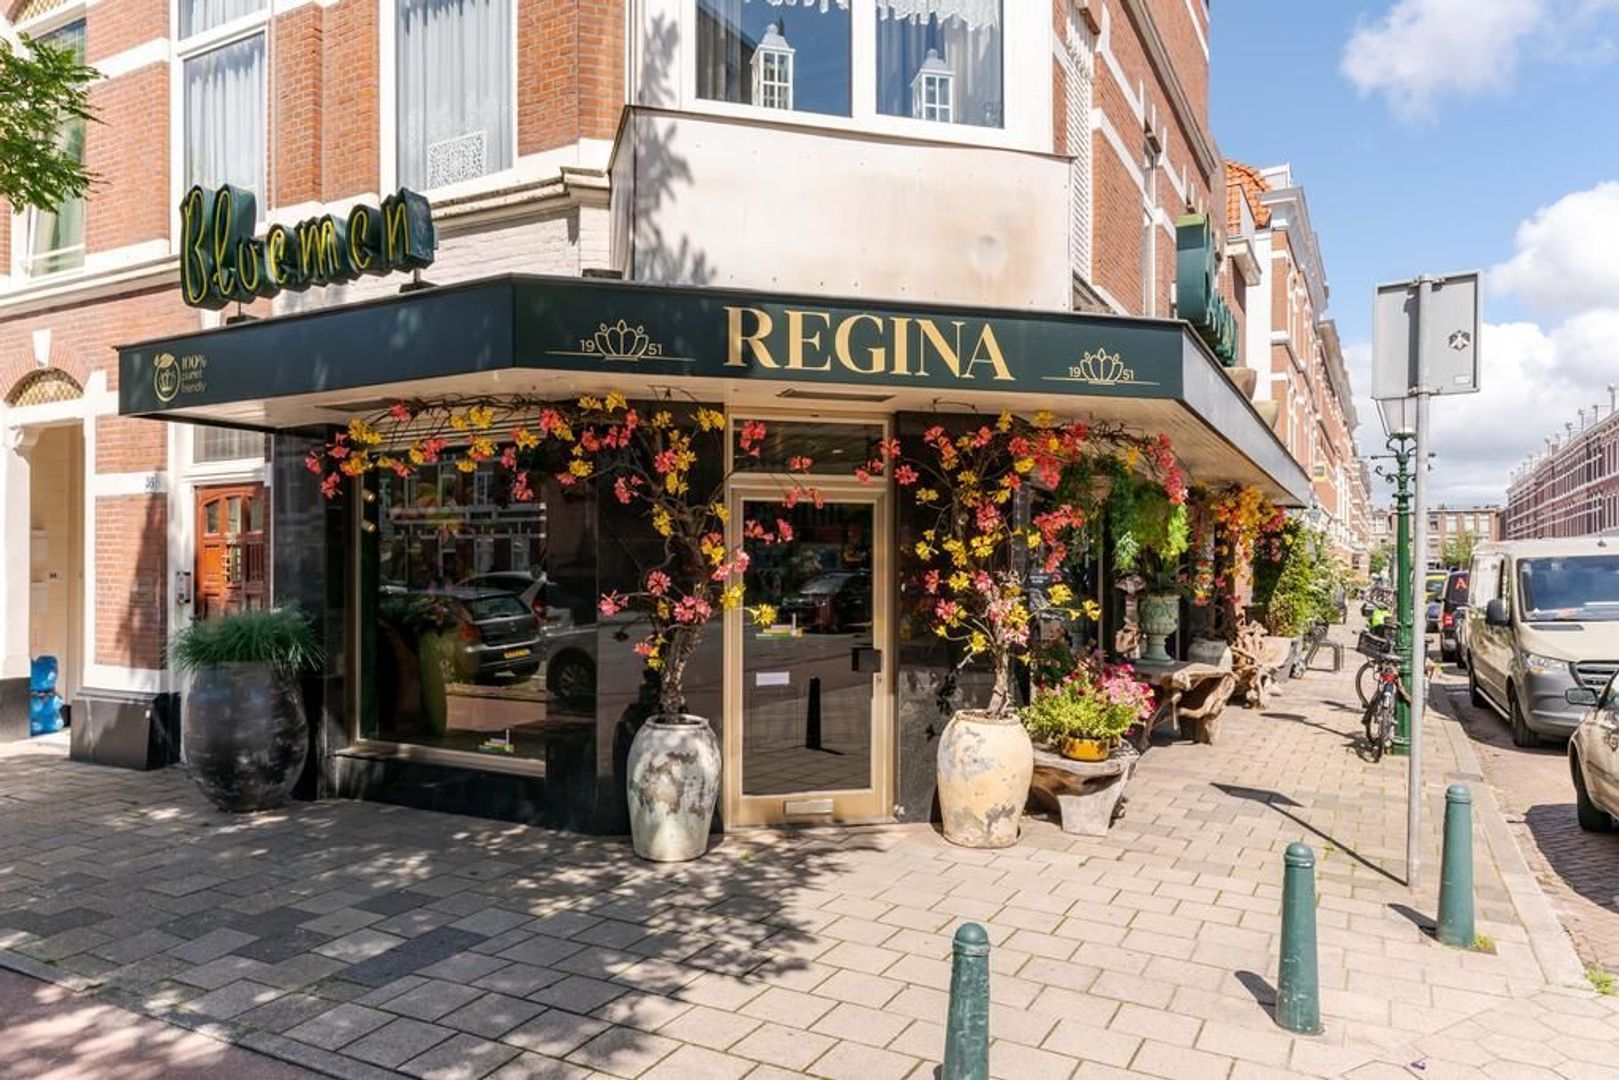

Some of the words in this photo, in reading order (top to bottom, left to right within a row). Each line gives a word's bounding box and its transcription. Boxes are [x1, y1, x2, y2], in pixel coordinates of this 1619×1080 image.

[181, 185, 416, 306] Bloemen
[580, 340, 596, 352] 19
[648, 343, 663, 355] 51
[723, 305, 1016, 381] REGINA
[182, 355, 207, 370] 100%
[1068, 366, 1081, 378] 19
[1122, 368, 1134, 380] 51
